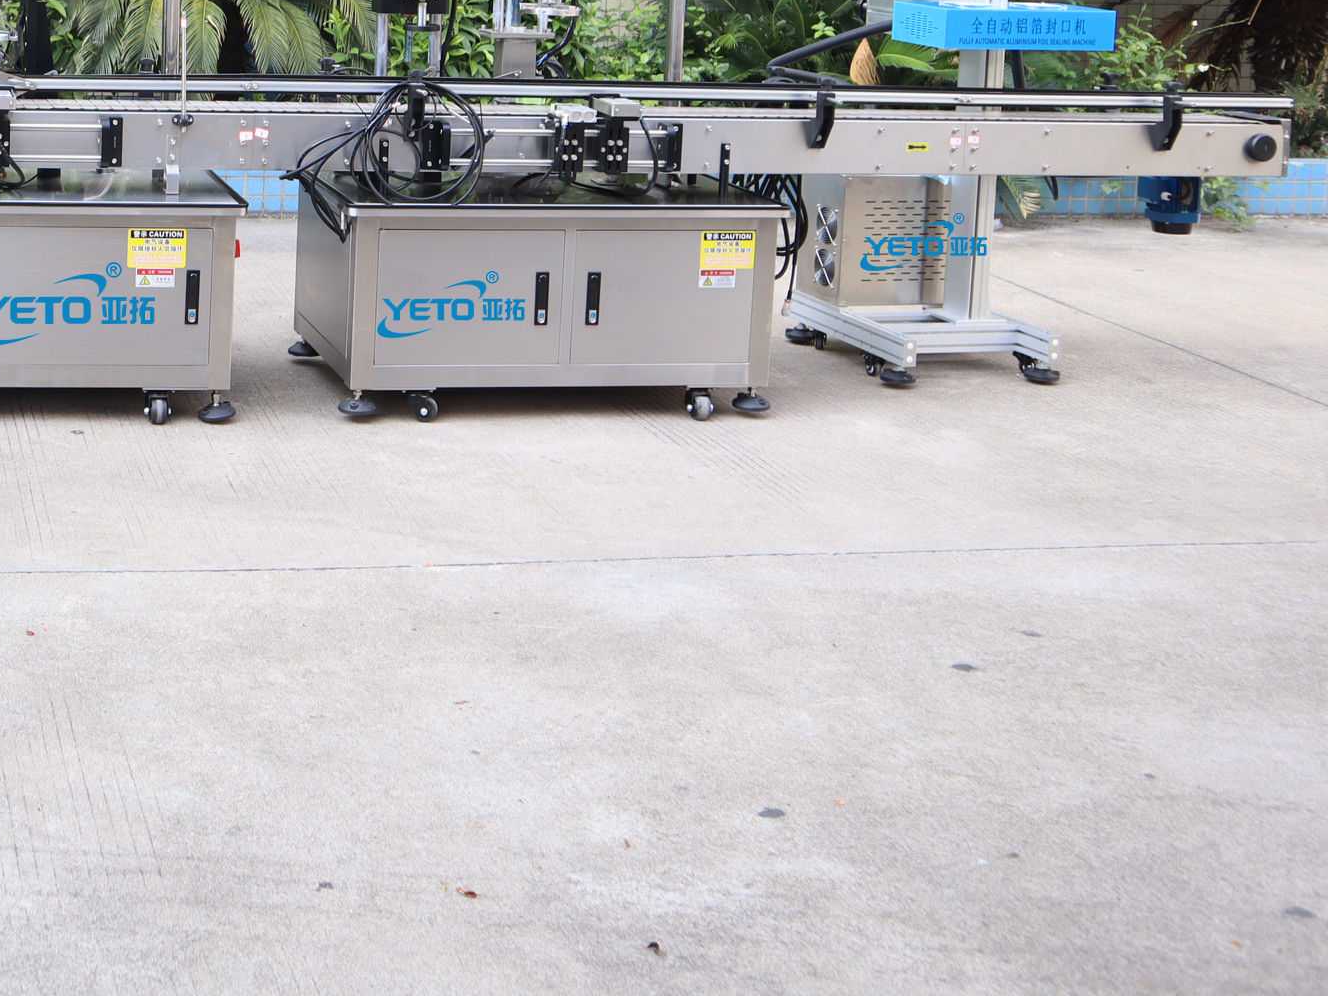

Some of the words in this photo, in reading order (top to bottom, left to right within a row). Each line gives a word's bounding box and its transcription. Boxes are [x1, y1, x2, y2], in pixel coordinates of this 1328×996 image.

[972, 16, 1087, 35] 全自动铝箔封口机
[148, 230, 183, 238] CAUTION
